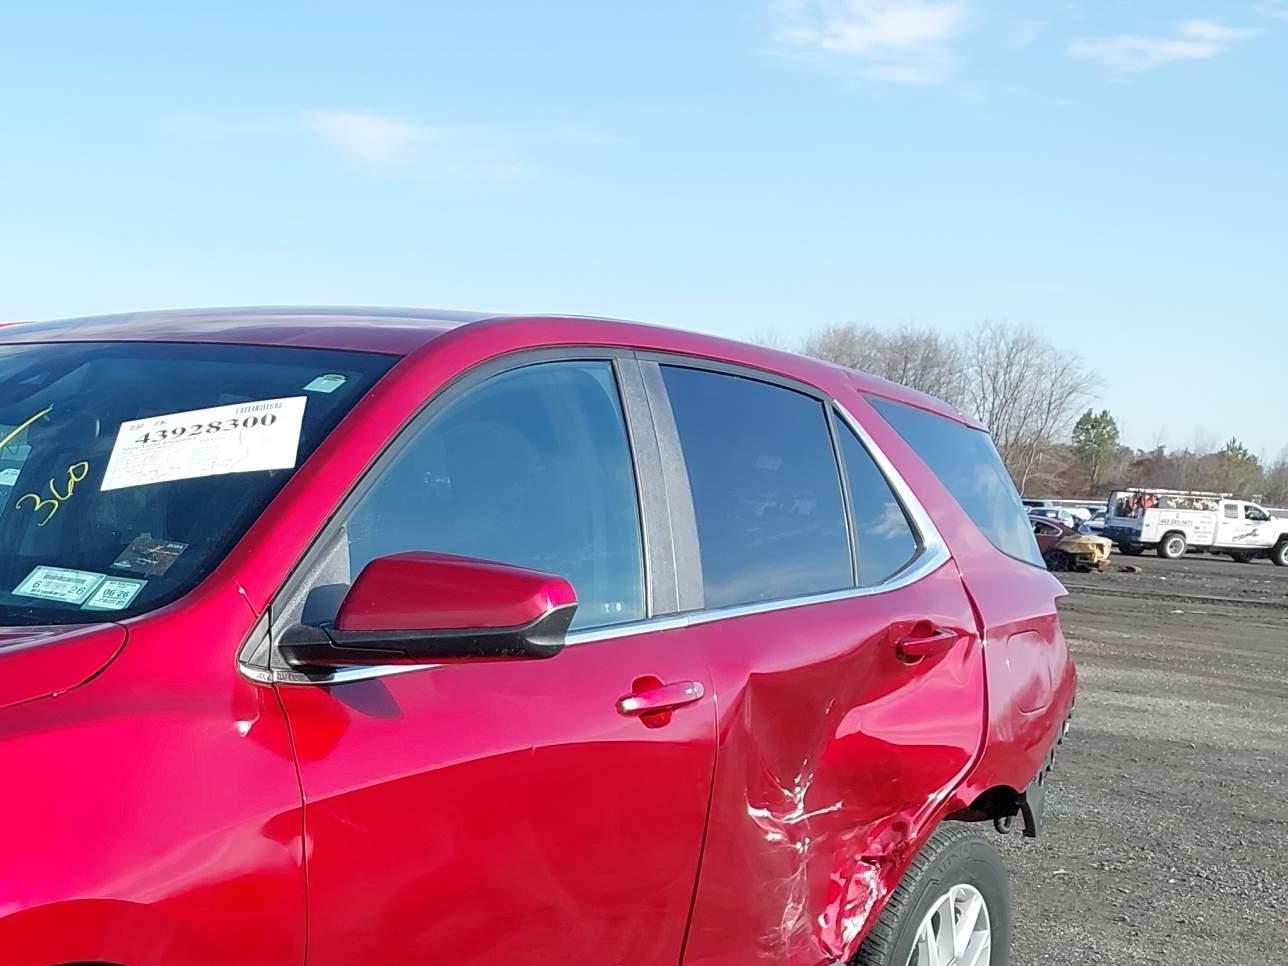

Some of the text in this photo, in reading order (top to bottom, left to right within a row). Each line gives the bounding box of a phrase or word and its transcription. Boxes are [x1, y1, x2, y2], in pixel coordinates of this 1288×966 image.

[135, 413, 278, 444] 43928300
[15, 461, 89, 526] 360
[67, 585, 86, 596] 26
